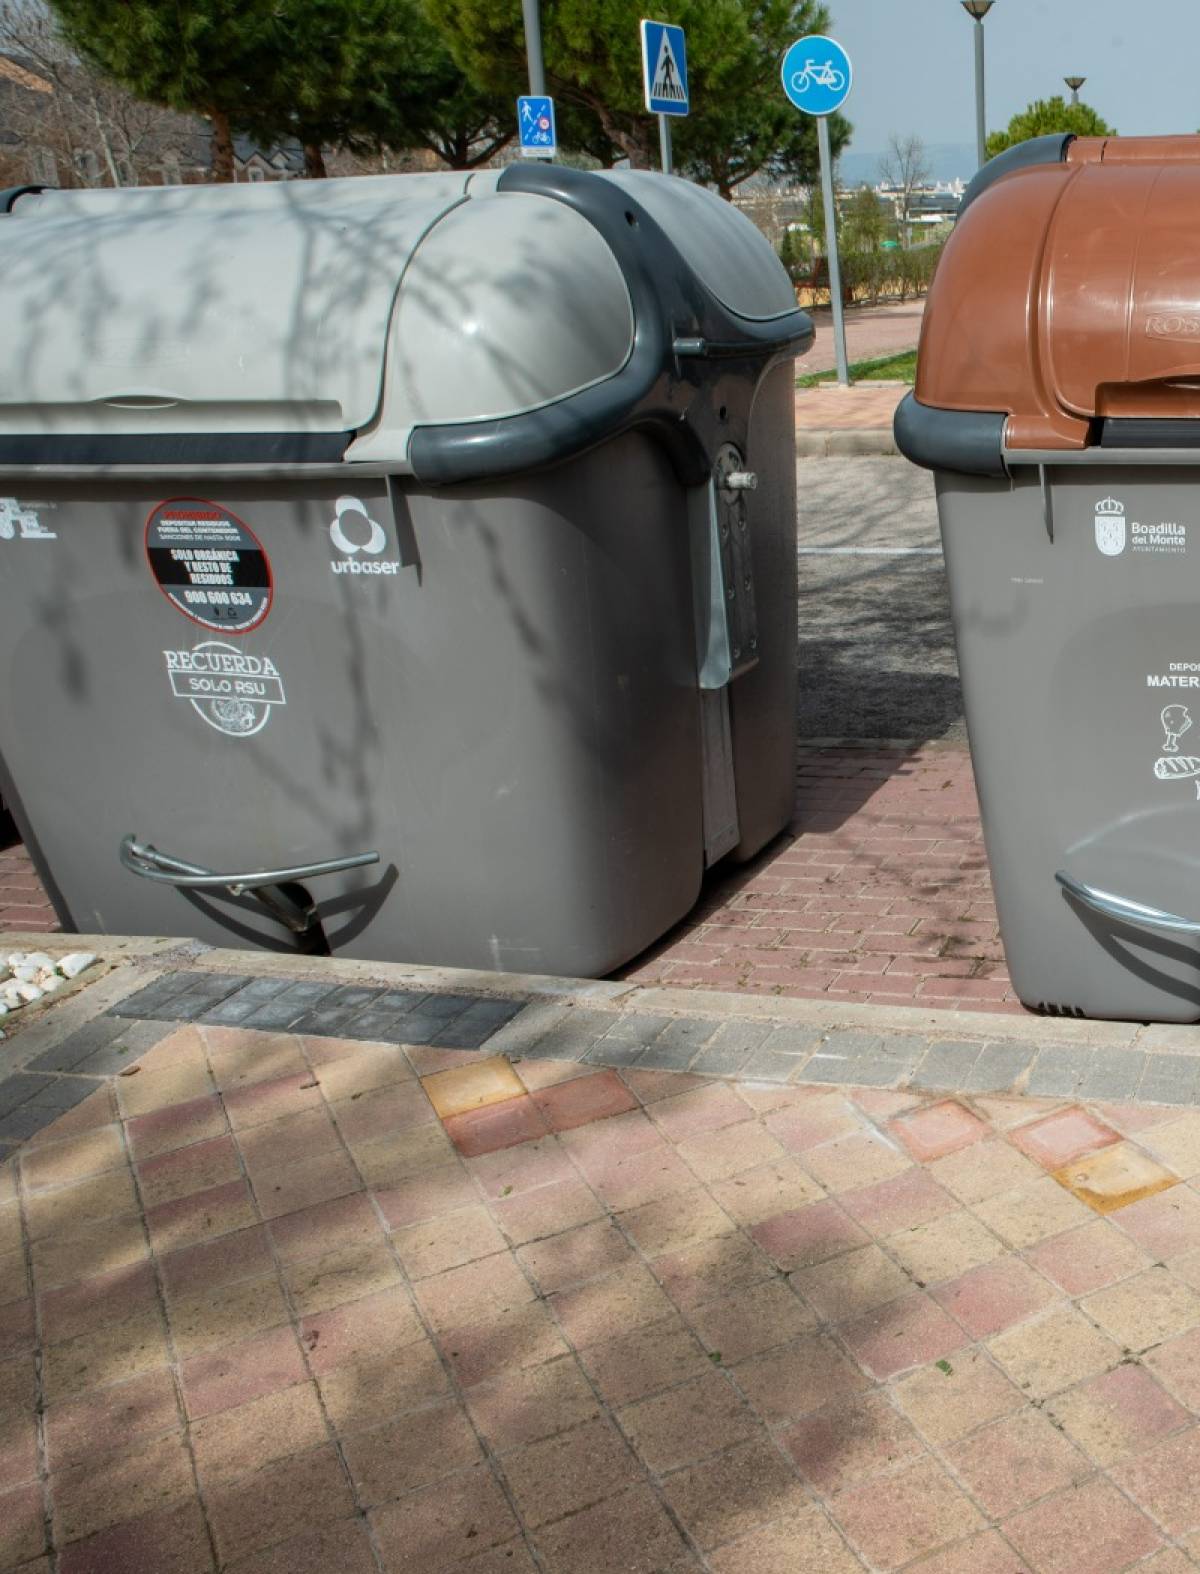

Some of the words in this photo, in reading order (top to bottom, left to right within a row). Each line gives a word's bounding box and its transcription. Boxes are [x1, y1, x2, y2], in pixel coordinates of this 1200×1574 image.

[1131, 521, 1186, 536] Boadilla
[1131, 535, 1148, 545] del
[1150, 535, 1186, 546] Monte
[330, 556, 400, 575] urbaser
[162, 650, 281, 676] RECUERDA
[189, 677, 232, 693] SOLO
[235, 681, 266, 696] RSU
